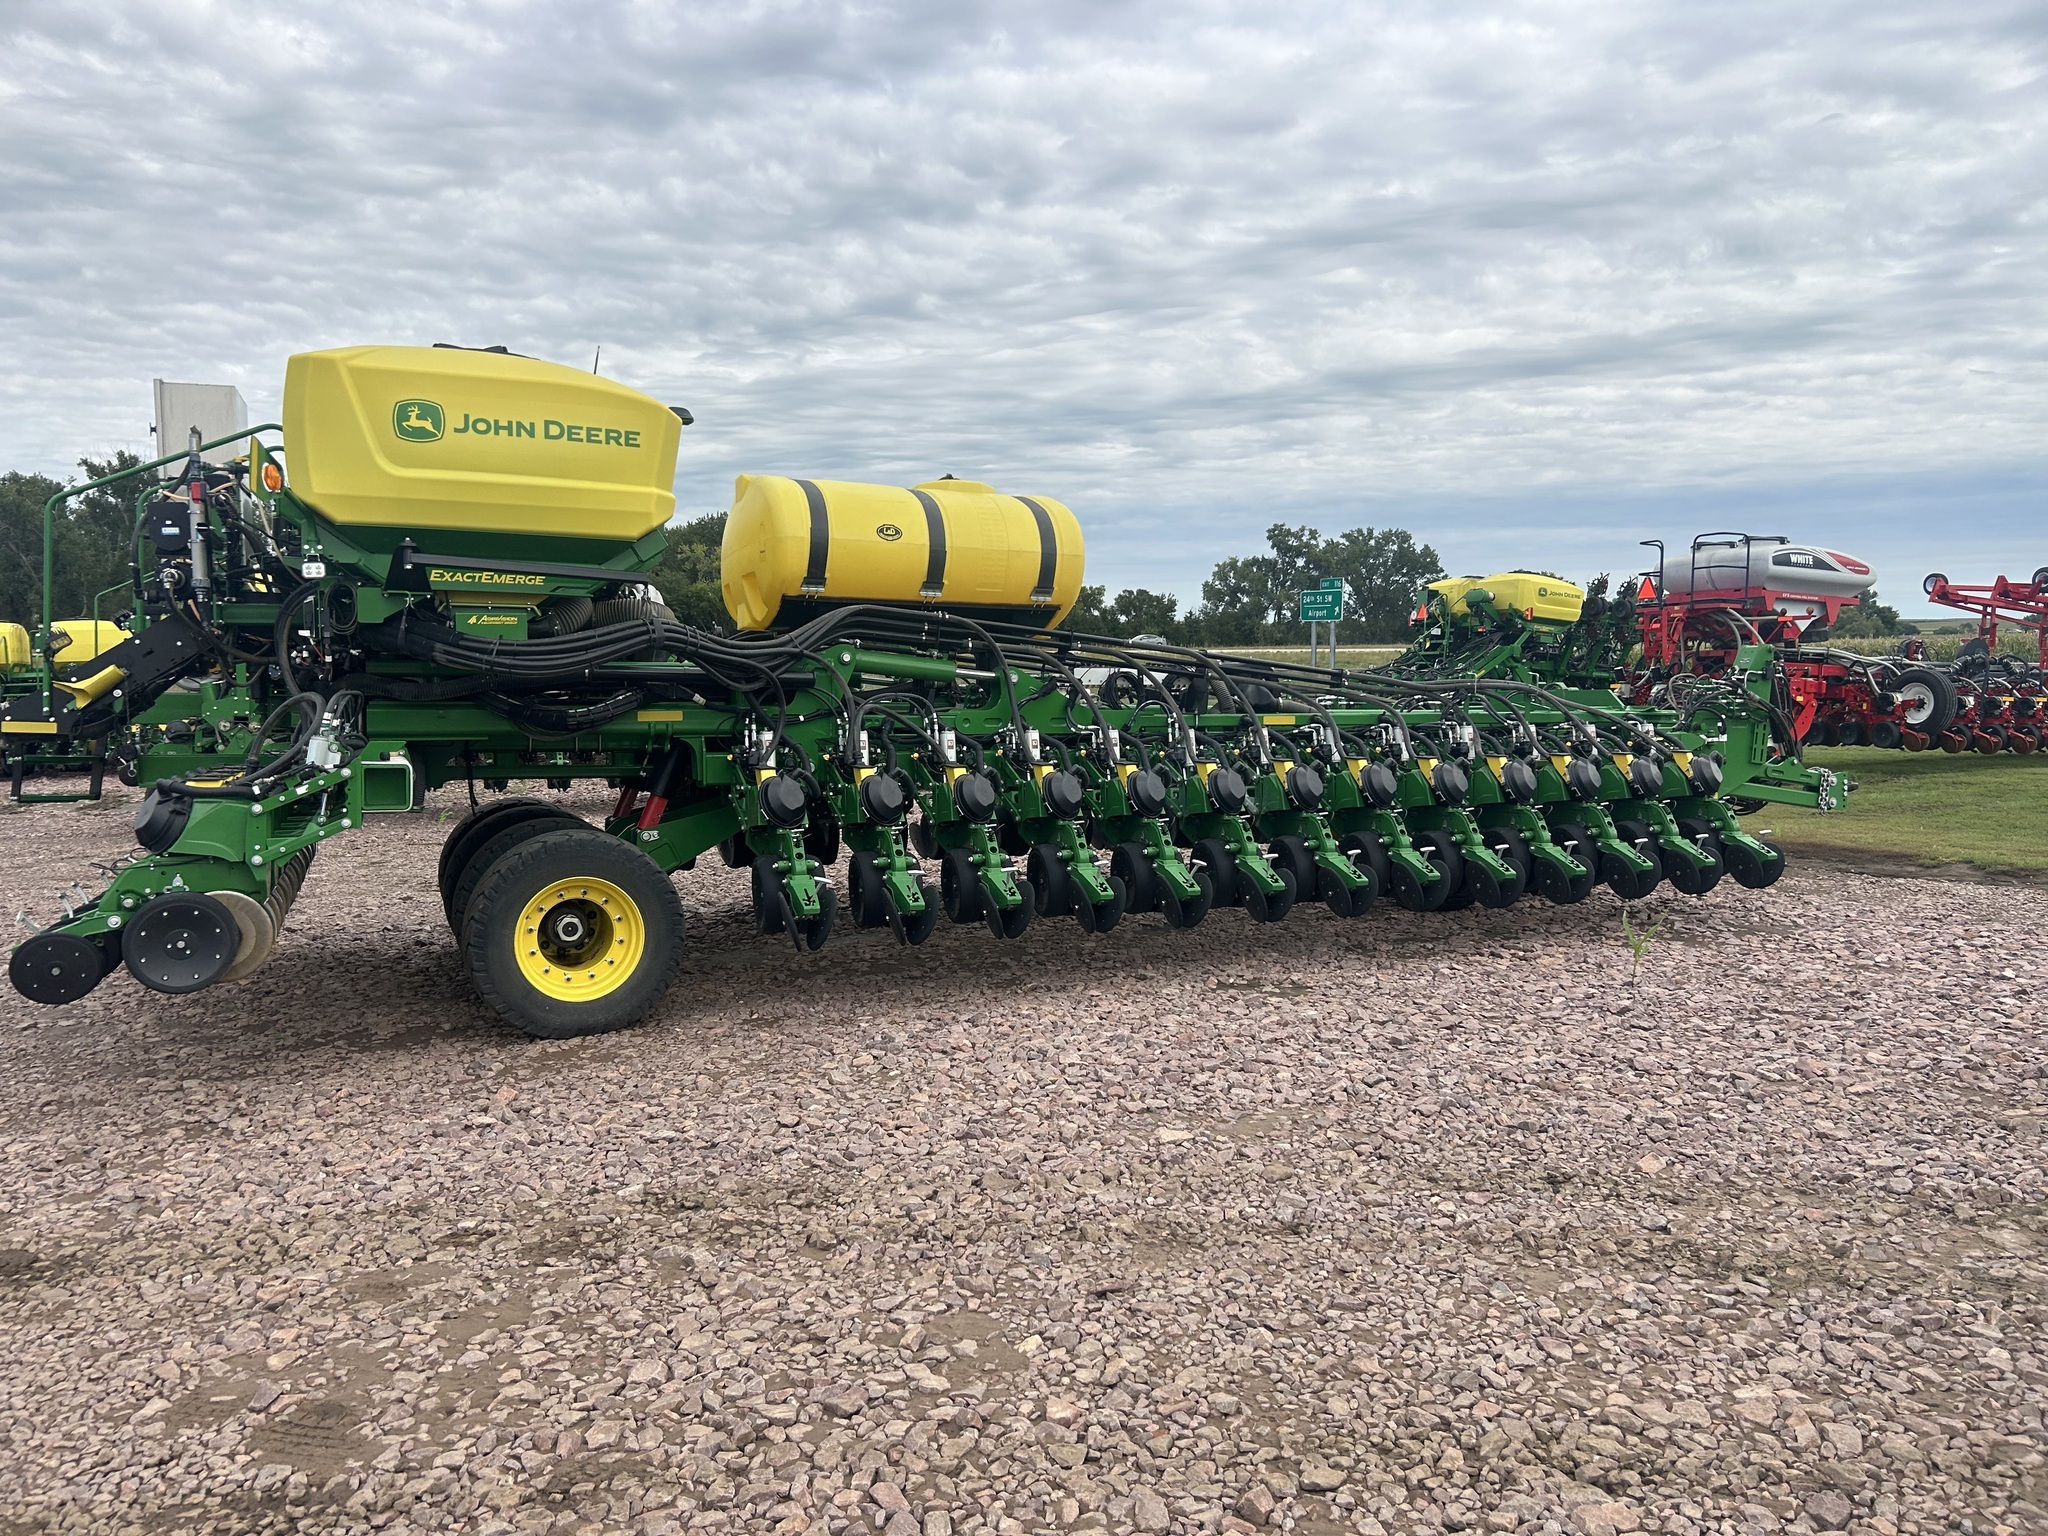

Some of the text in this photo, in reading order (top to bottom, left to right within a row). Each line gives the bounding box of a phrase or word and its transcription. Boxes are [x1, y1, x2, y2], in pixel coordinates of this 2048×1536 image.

[454, 413, 641, 448] JOHN DEERE
[1789, 554, 1813, 564] WHITE
